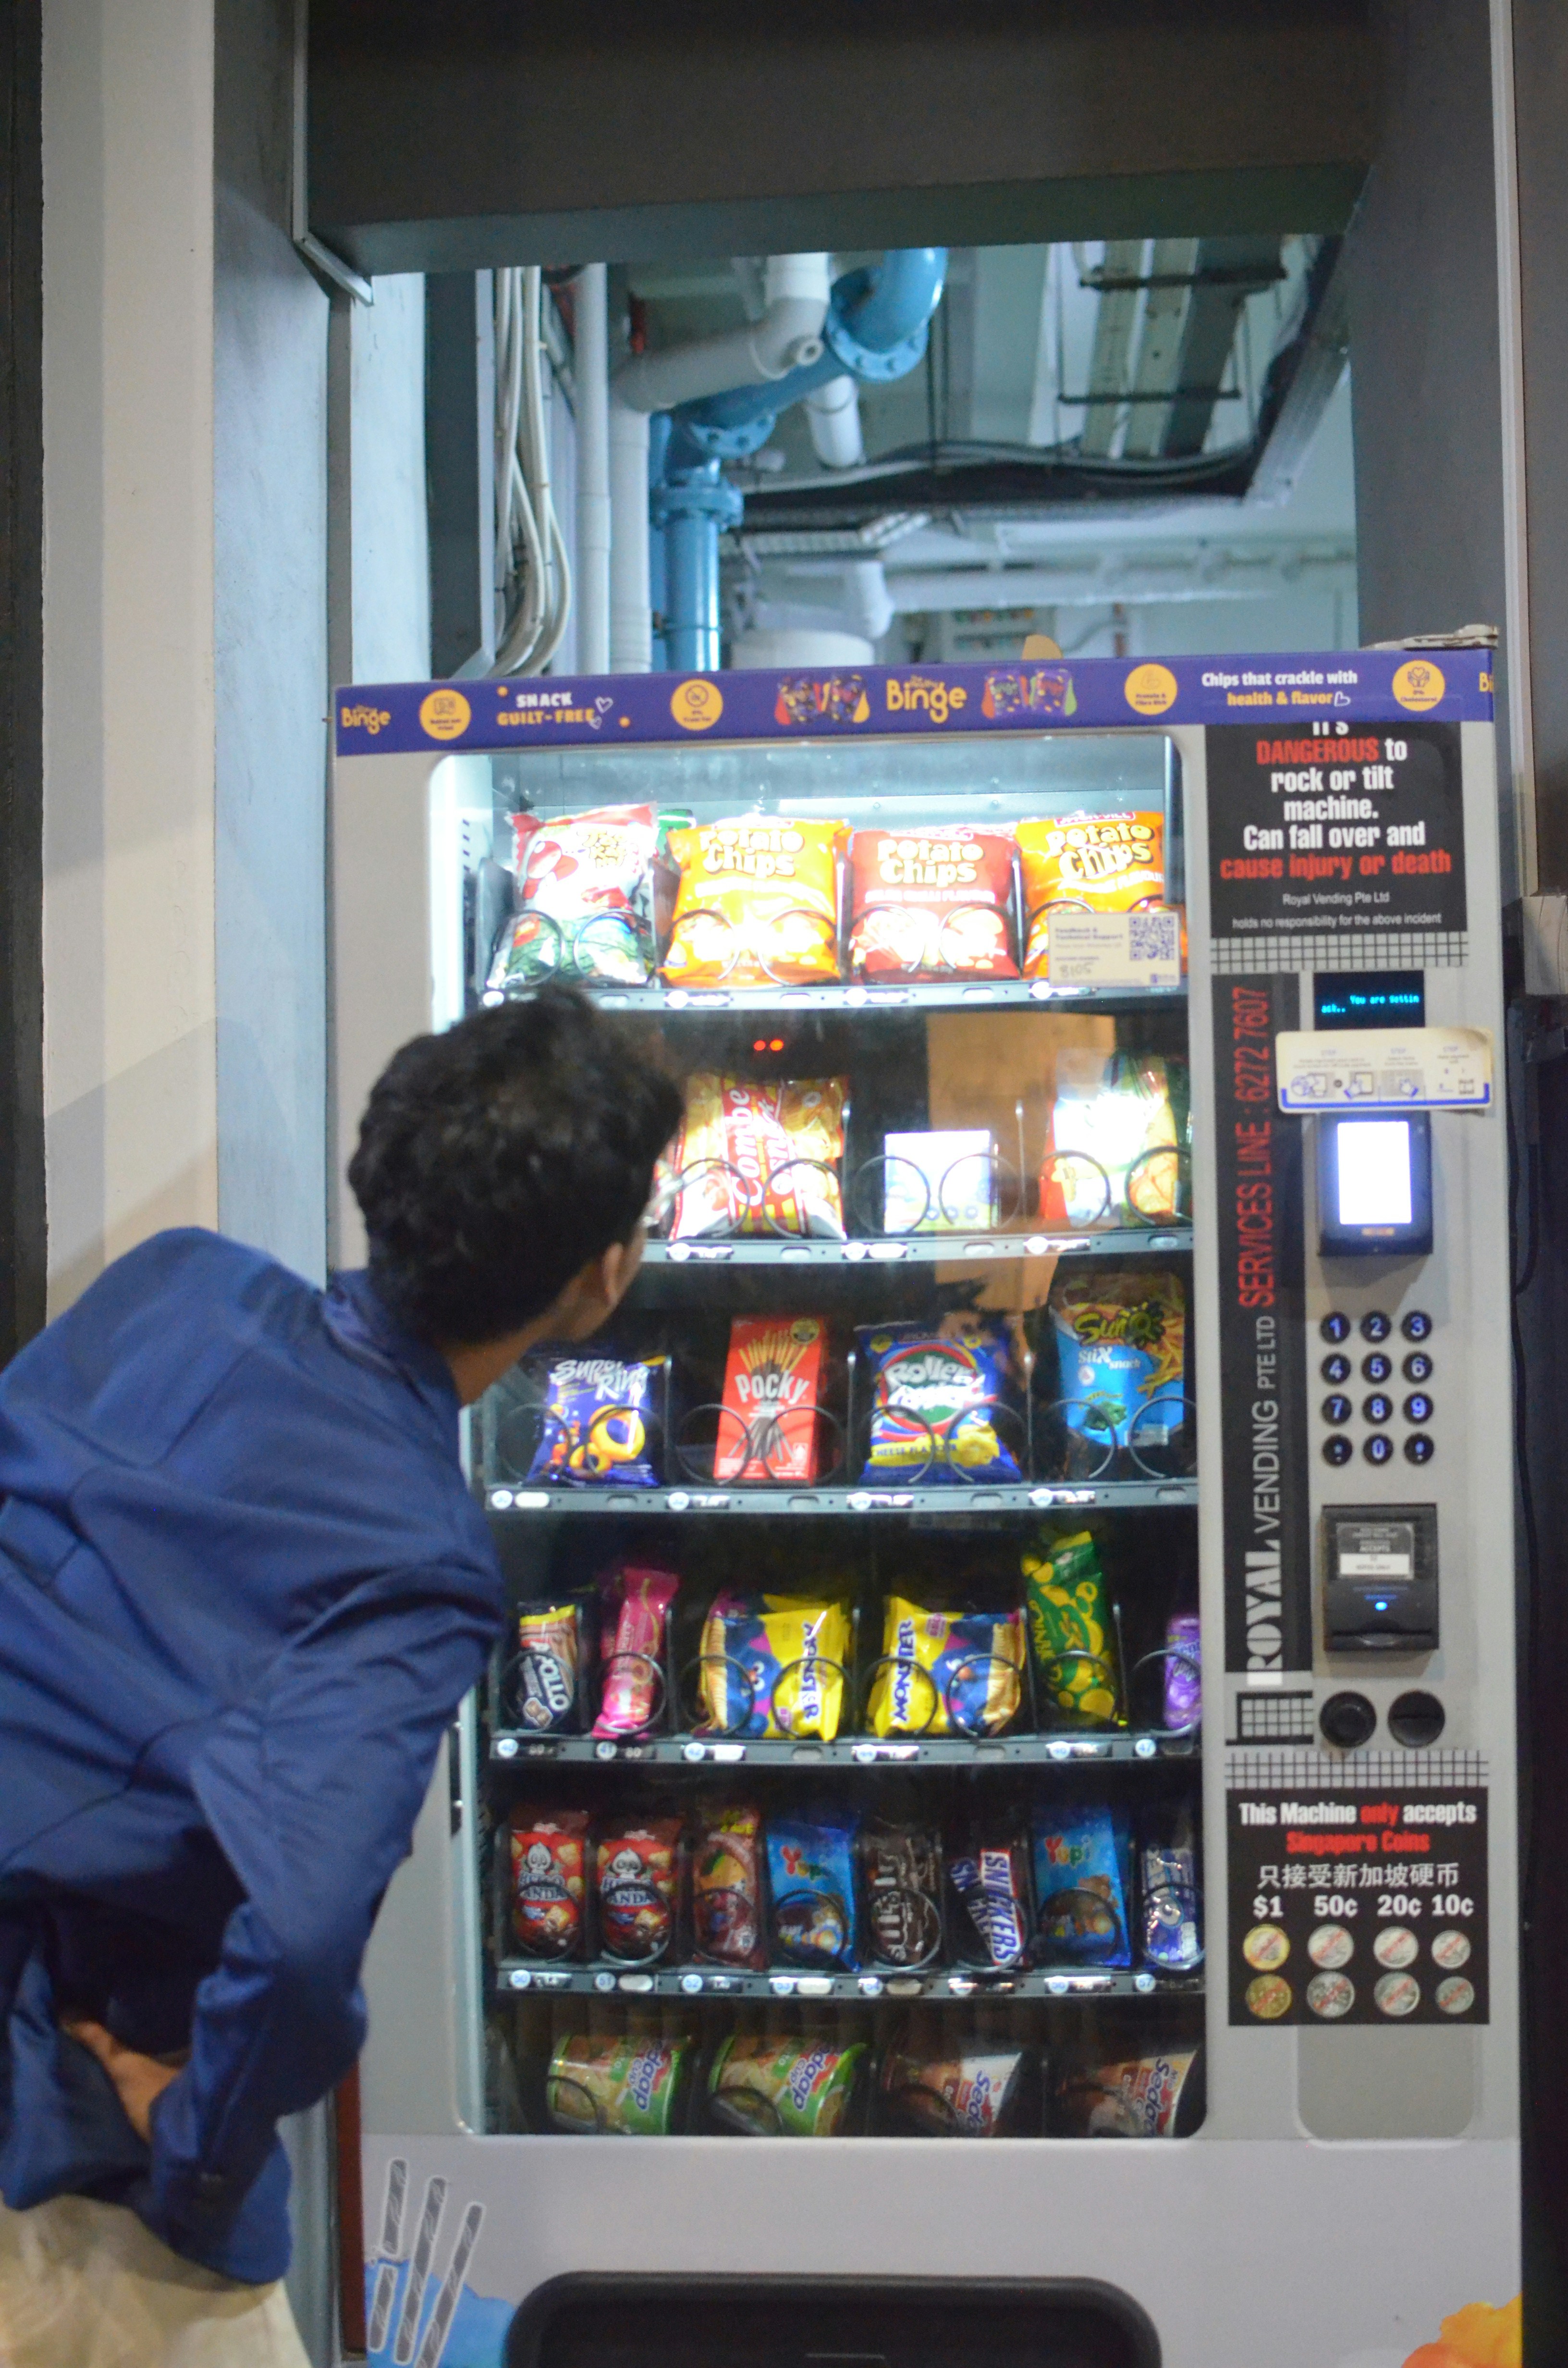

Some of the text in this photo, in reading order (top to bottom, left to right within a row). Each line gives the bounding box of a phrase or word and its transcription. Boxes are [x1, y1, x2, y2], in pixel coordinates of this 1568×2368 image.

[1201, 670, 1358, 688] Chips that crackle with
[516, 692, 573, 708] SNACK
[886, 678, 967, 724] Binge
[1227, 691, 1333, 706] health & flavor
[497, 708, 595, 726] GUILT-FREE
[1256, 736, 1407, 765] DANGEROUS to
[1271, 765, 1394, 792] rock or tilt
[1284, 795, 1379, 821] machine.
[699, 829, 805, 853] Potato
[1045, 823, 1154, 858] Potato
[1243, 821, 1425, 851] Can fall over and
[703, 844, 796, 878] Chips
[878, 839, 984, 862] Potato
[1058, 842, 1153, 879] Chips
[880, 859, 977, 888] Chips
[1220, 849, 1451, 881] cause injury or death
[1282, 891, 1390, 908] Royal Vending Pte Ltd
[1232, 913, 1442, 929] holds no responsibility for the above incident
[1350, 995, 1366, 1004] You
[1232, 986, 1268, 1041] 7607
[1234, 1047, 1270, 1103] 6272
[1236, 1121, 1273, 1175] LINE
[1237, 1183, 1276, 1307] SERVICES
[1330, 1319, 1341, 1337] 1
[1370, 1318, 1382, 1336] 2
[1410, 1317, 1423, 1336] 3
[1329, 1358, 1343, 1378] 4
[1371, 1359, 1384, 1378] 5
[1411, 1358, 1424, 1377] 6
[1331, 1399, 1343, 1418] 7
[1372, 1399, 1384, 1418] 8
[1412, 1398, 1425, 1418] 9
[1372, 1441, 1384, 1459] 0
[1245, 1316, 1283, 1685] ROYAL VENDING PTE LTD
[894, 1619, 916, 1722] MONSTER
[1139, 1742, 1153, 1752] 47
[1239, 1801, 1477, 1826] This Machine only accepts
[1286, 1829, 1430, 1856] Singapore Coins
[1257, 1862, 1459, 1889] 只接受新加坡硬币
[1253, 1895, 1284, 1919] $1
[686, 1979, 699, 1988] 52
[1139, 1976, 1152, 1987] 57
